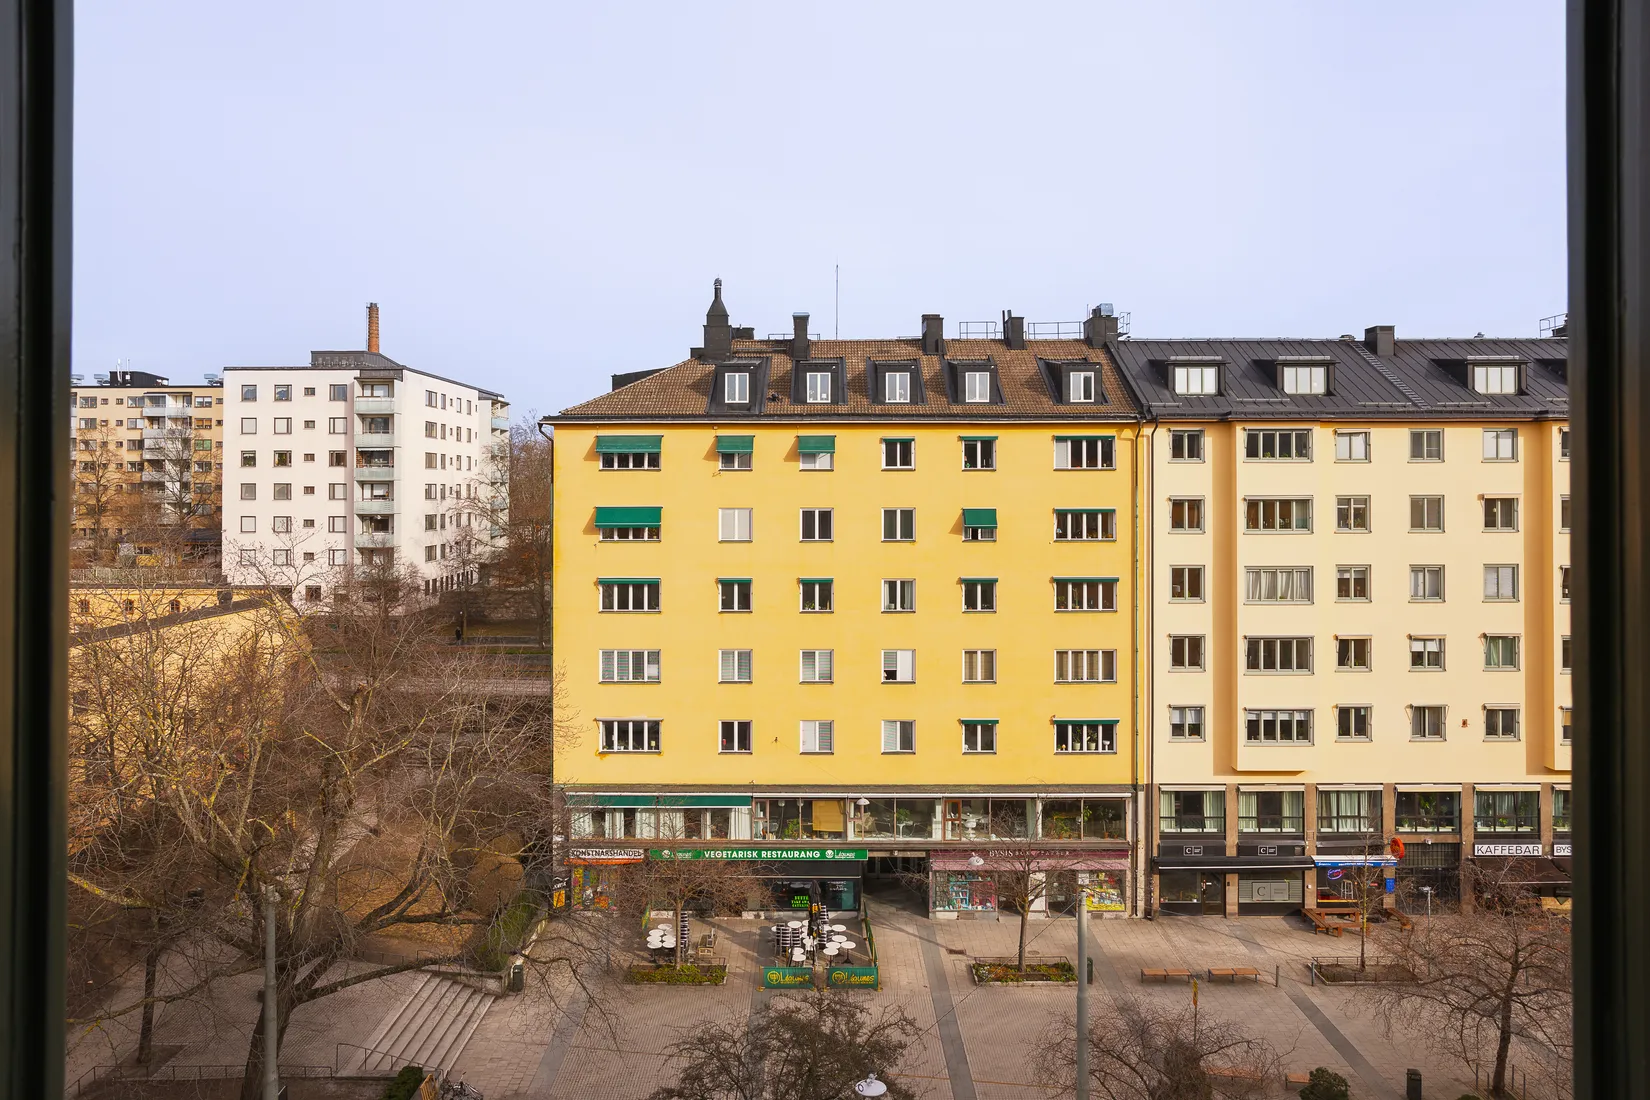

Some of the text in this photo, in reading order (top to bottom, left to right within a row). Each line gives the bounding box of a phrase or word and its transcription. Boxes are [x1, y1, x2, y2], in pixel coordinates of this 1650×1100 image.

[704, 850, 820, 858] VEGETARISK RESTAURANG
[1476, 845, 1540, 855] KAFFEBAR
[1257, 886, 1266, 897] C
